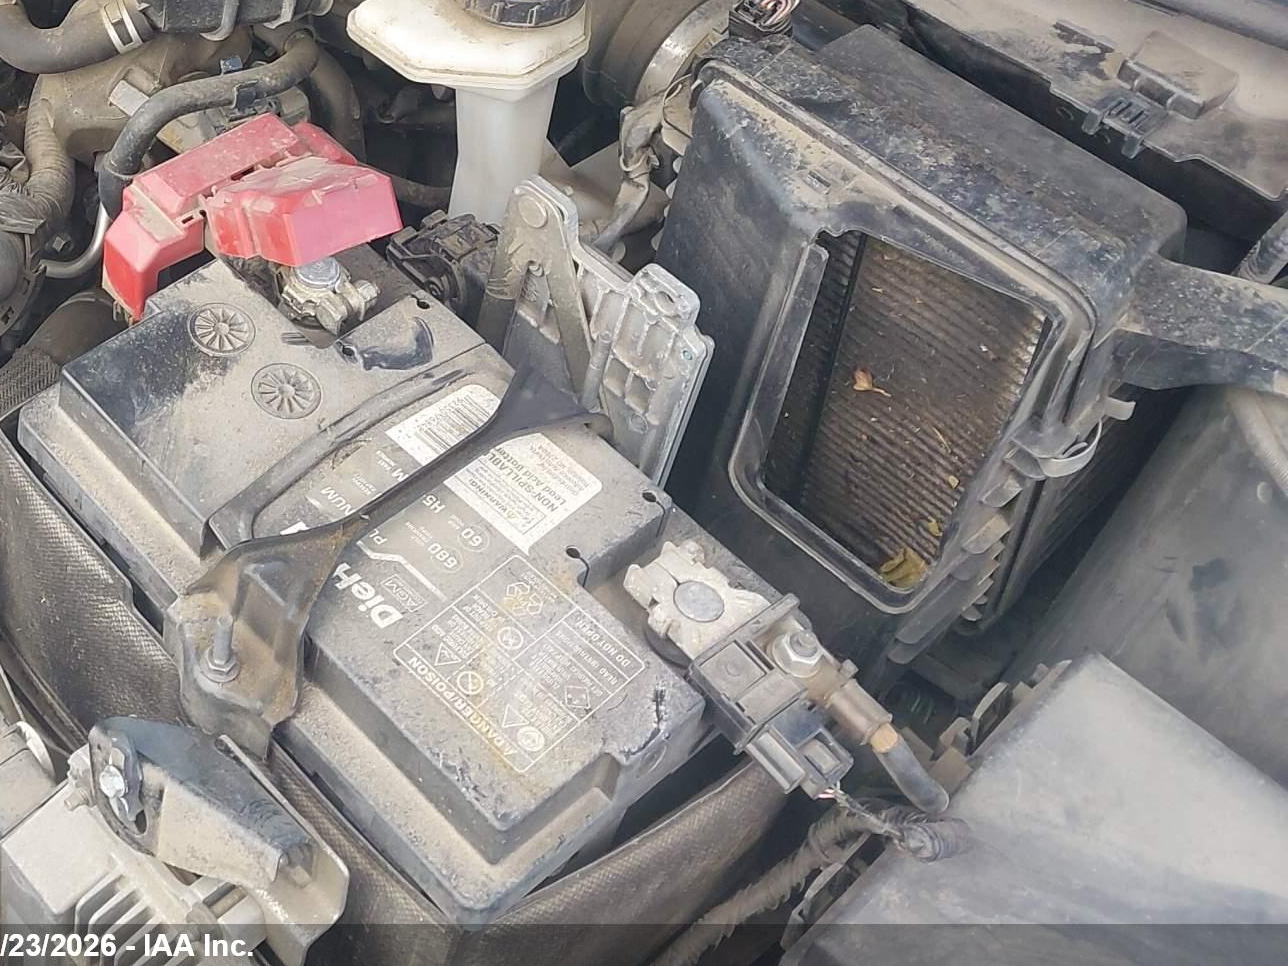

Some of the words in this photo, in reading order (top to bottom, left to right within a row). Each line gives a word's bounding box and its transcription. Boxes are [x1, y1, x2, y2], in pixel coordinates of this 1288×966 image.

[492, 444, 525, 471] Batter
[520, 468, 545, 488] Acid
[540, 484, 567, 507] Lead
[458, 526, 484, 548] 60
[425, 540, 459, 569] 680
[383, 577, 418, 609] AGM
[596, 638, 618, 656] NOT
[613, 652, 632, 668] DO
[405, 654, 507, 748] DANGER/POISON
